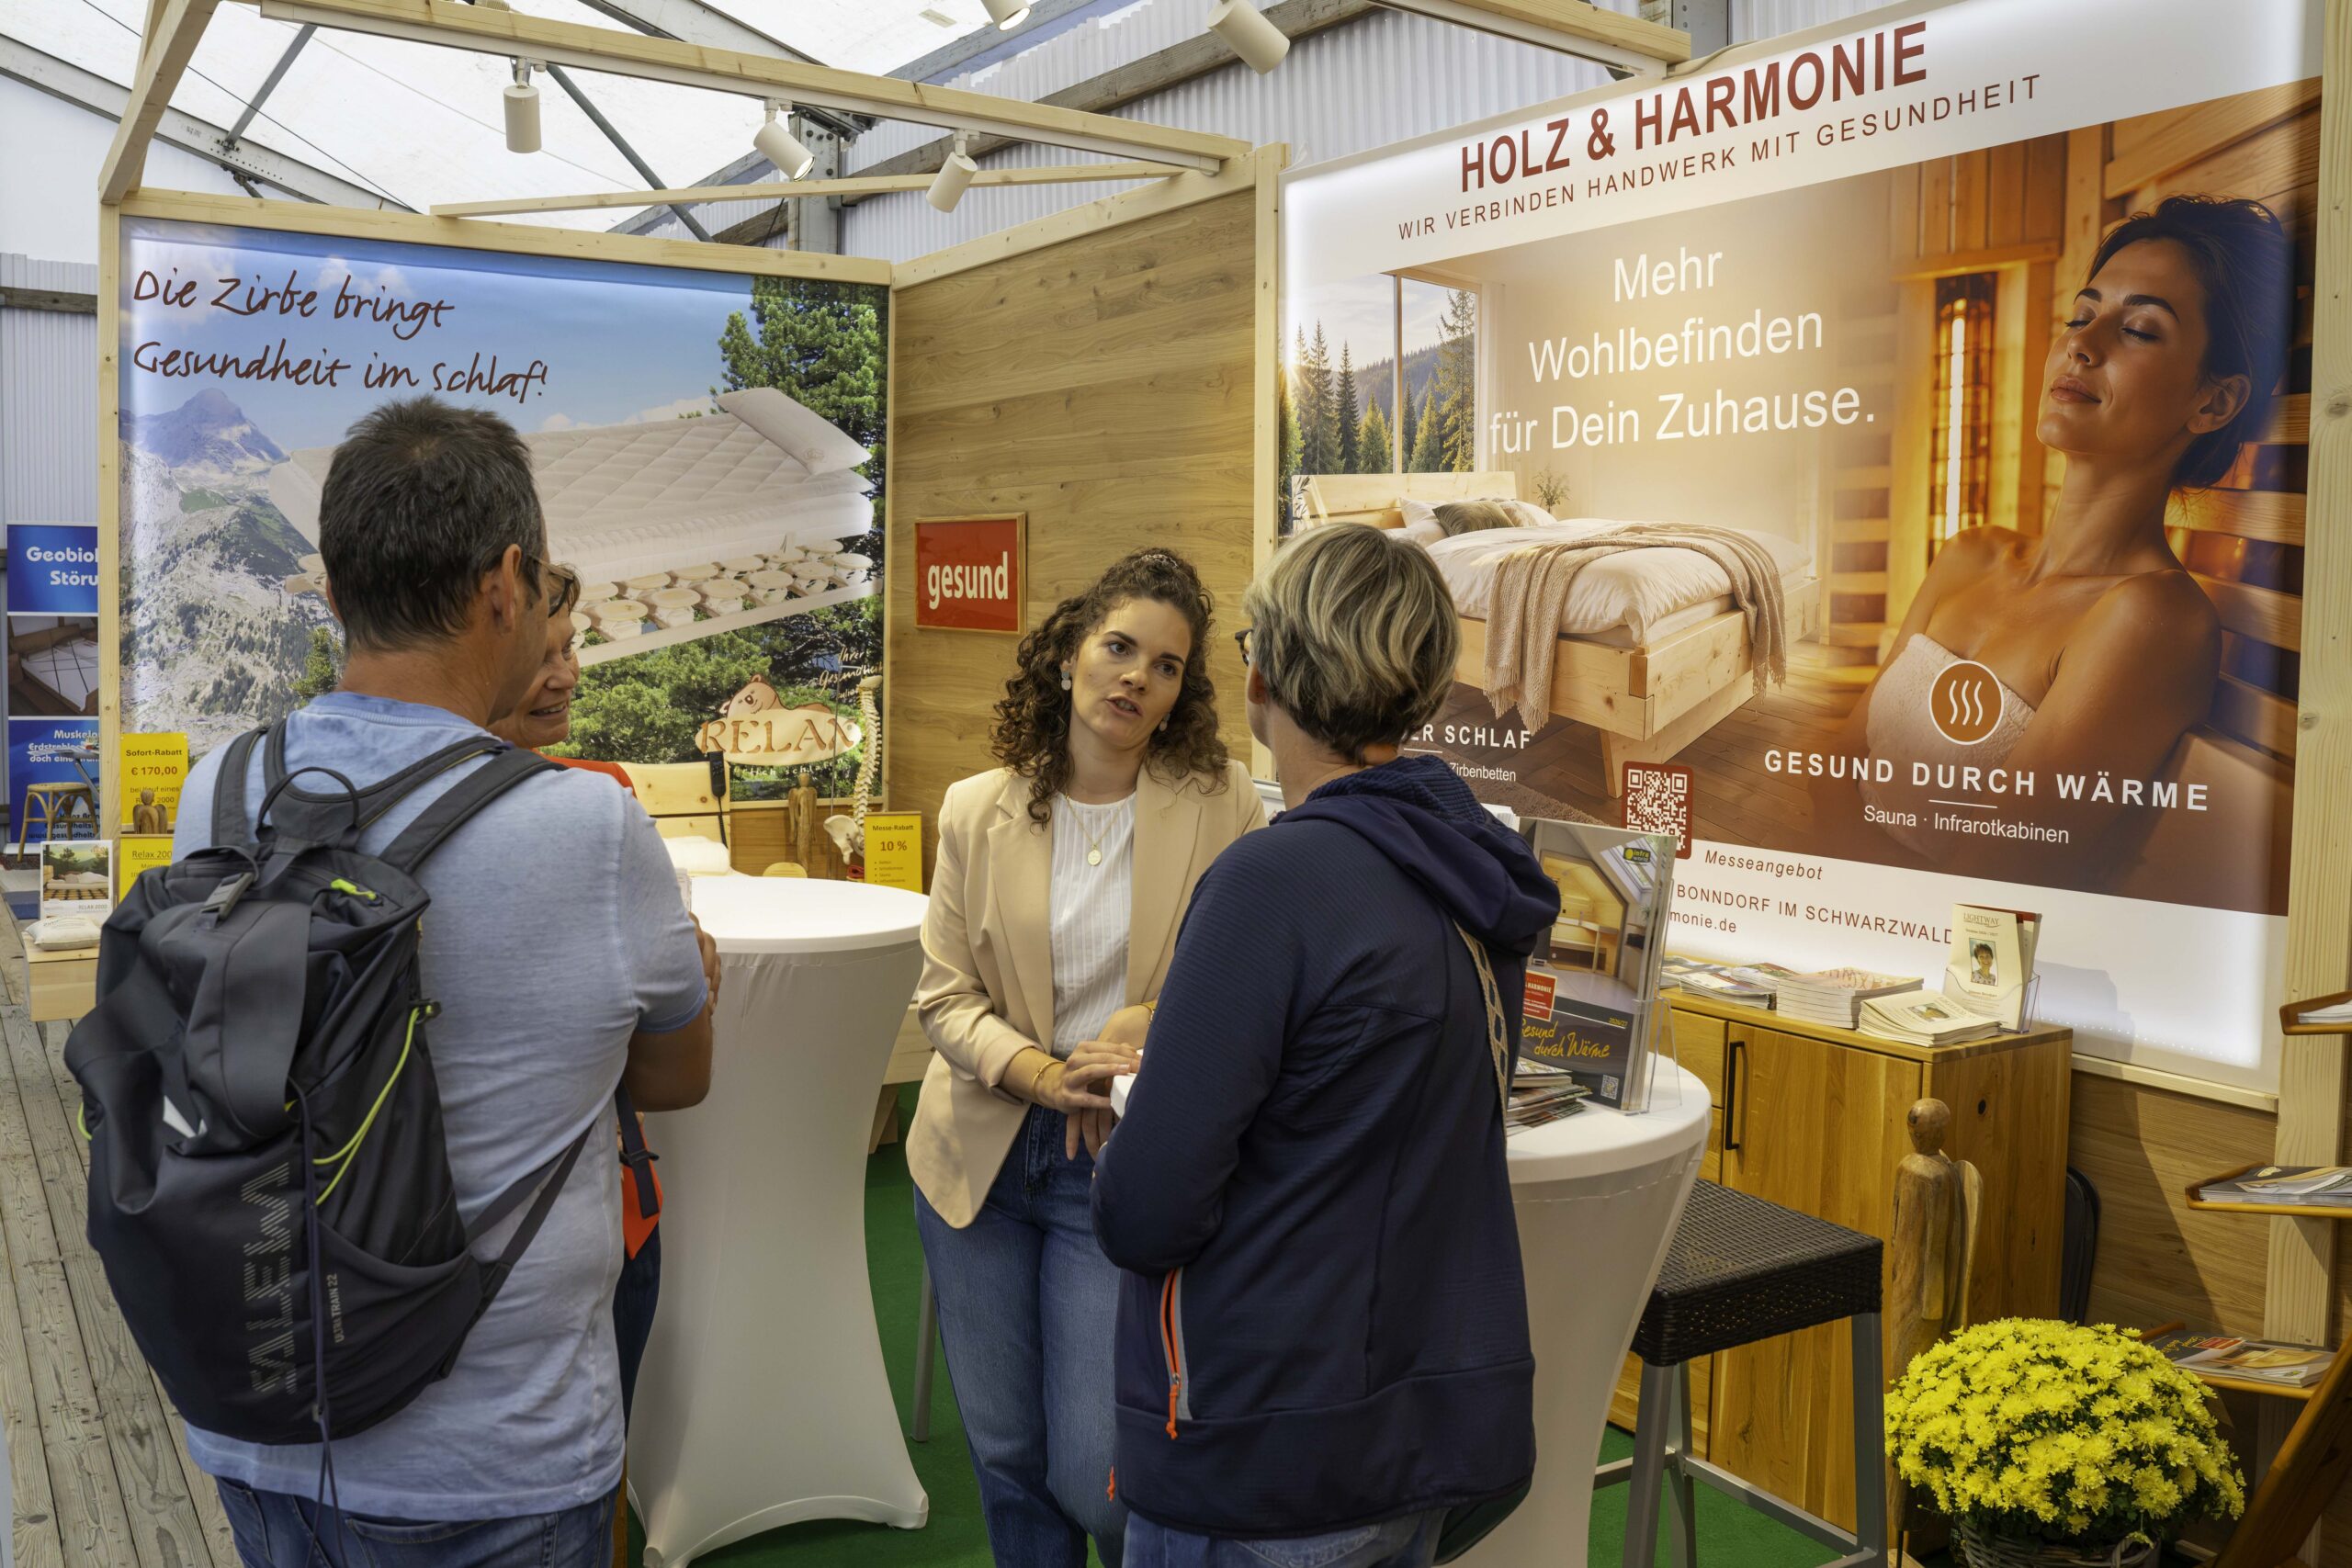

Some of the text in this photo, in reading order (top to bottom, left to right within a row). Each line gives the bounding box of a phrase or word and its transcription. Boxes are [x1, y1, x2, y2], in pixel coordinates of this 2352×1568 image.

[1461, 20, 1928, 193] HOLZ & HARMONIE
[1398, 73, 2041, 241] WIR VERBINDEN HANDWERK MIT GESUNDHEIT
[1613, 248, 1723, 302] Mehr
[133, 267, 197, 309] Die
[334, 275, 455, 341] bringt
[133, 339, 351, 388] Gesundheit
[364, 352, 419, 389] im
[1529, 312, 1823, 383] Wohlbefinden
[1489, 386, 1875, 455] für Dein Zuhause.
[928, 551, 1008, 610] gesund
[126, 749, 183, 757] Sofort-Rabatt
[700, 717, 857, 754] RELAX
[1444, 725, 1531, 750] SCHLAF
[130, 766, 178, 777] € 170,00
[1449, 762, 1516, 782] Zirbenbetten
[1764, 750, 2209, 811] GESUND DURCH WÄRME
[1863, 805, 2069, 844] Sauna Infrarotkabinen
[880, 840, 908, 852] 10 %
[1705, 850, 1823, 880] Messeangebot
[1669, 910, 1737, 933] monie.de
[1677, 885, 1951, 944] BONNDORF IM SCHWARZWALD
[1963, 913, 1999, 926] LIGHTWAY
[1534, 1032, 1611, 1058] durch Wärme
[325, 1273, 338, 1287] 22
[328, 1288, 342, 1317] TRAIN
